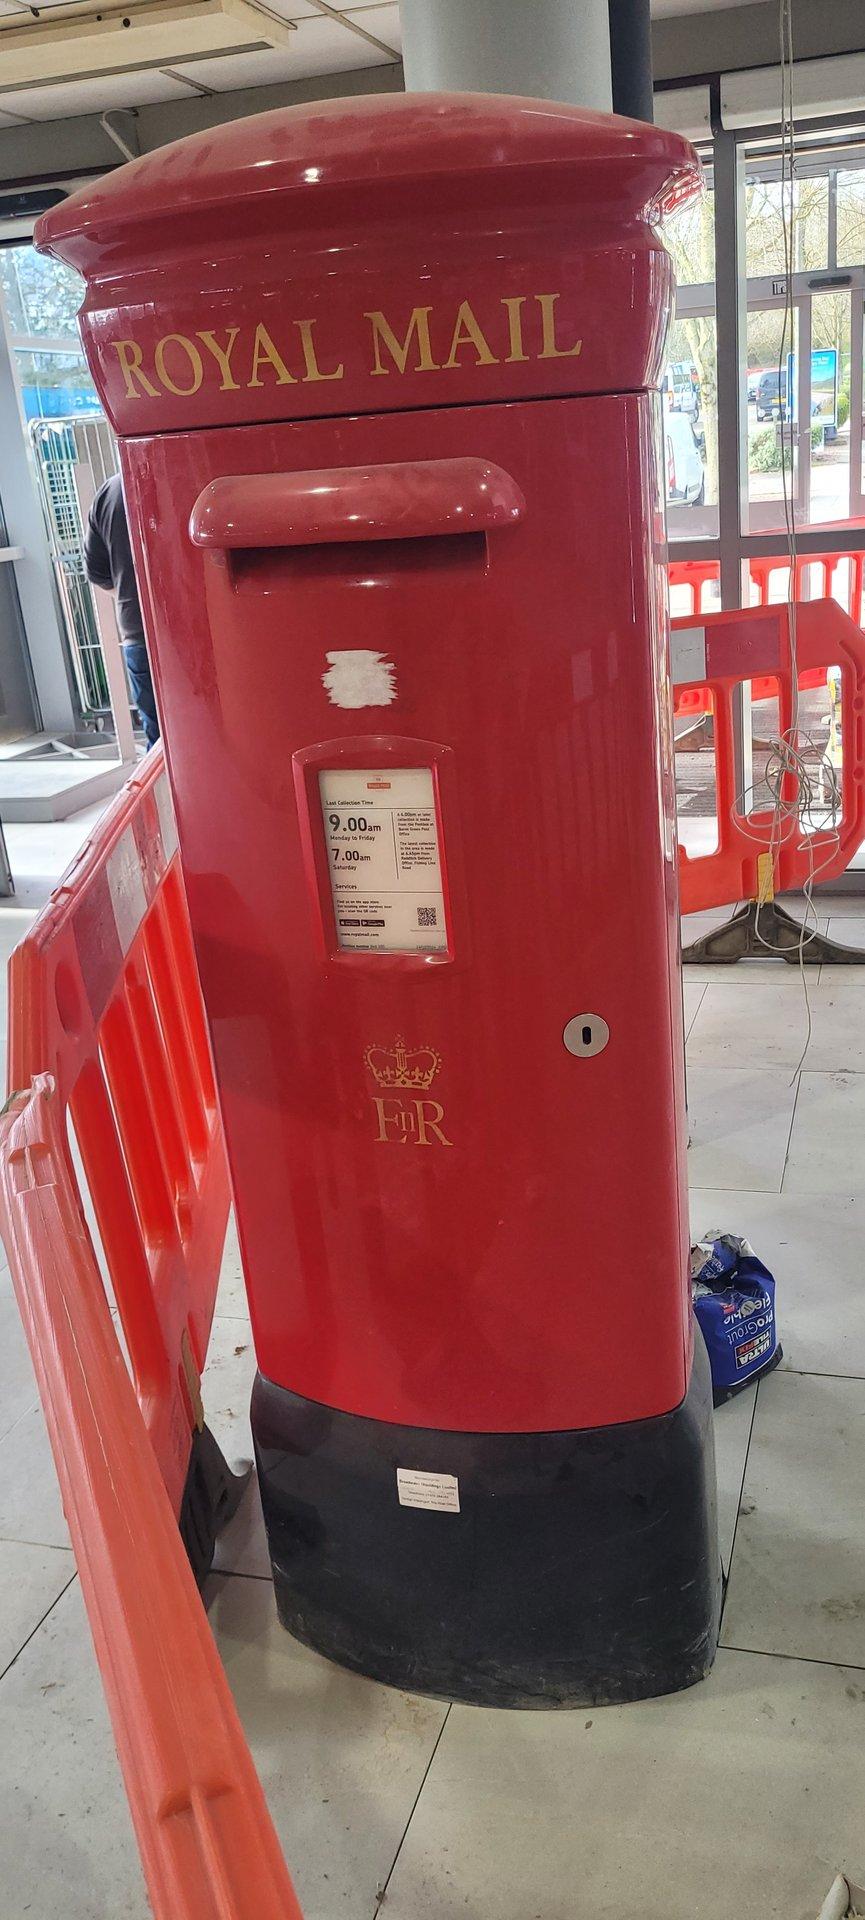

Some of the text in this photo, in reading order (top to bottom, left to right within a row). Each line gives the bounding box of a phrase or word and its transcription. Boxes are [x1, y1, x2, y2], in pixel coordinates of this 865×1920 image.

[110, 293, 583, 400] ROYAL MAIL
[329, 814, 381, 831] 9.00am
[331, 848, 371, 861] 7.00am
[739, 1338, 771, 1363] ULTRA
